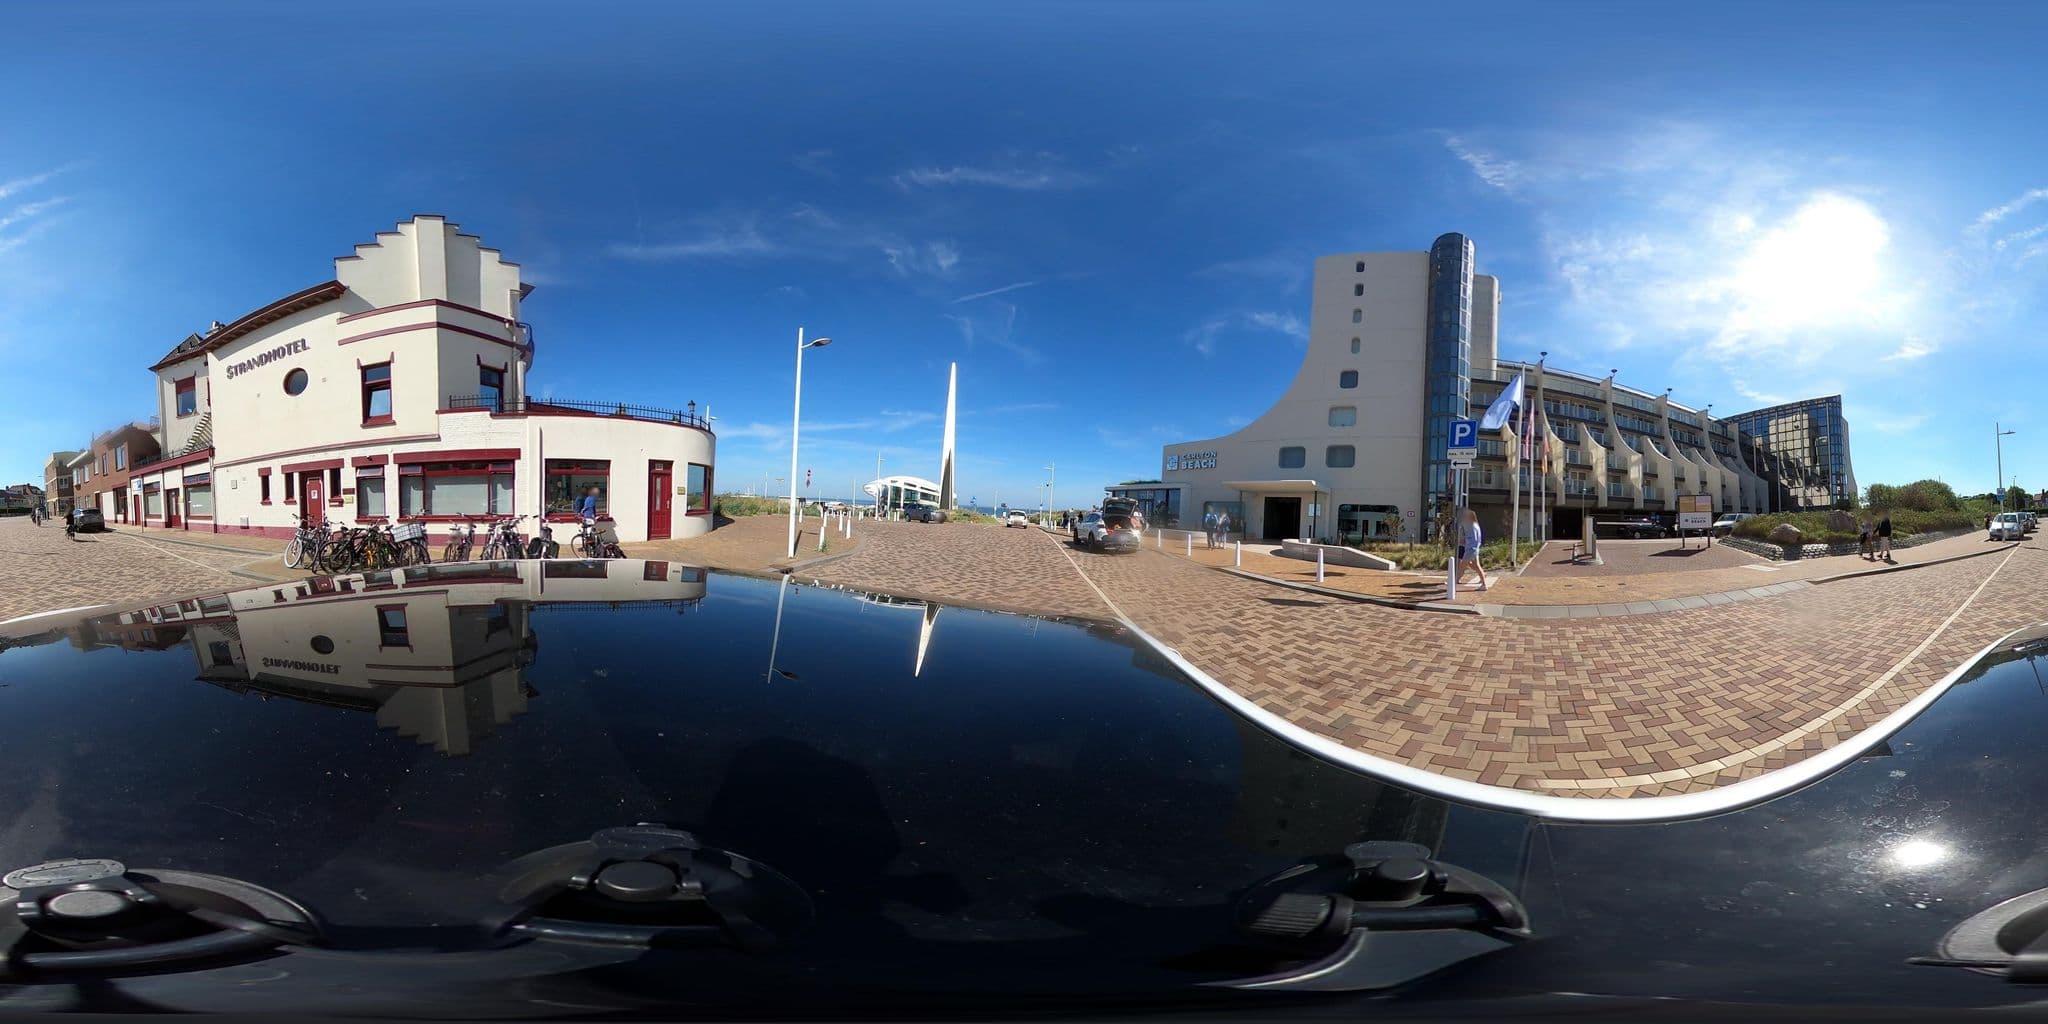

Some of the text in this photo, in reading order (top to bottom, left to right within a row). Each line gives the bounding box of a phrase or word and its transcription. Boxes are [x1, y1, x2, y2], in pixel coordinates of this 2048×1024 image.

[226, 338, 310, 379] STRANDHOTEL
[1455, 424, 1471, 445] P
[1181, 459, 1217, 470] BEACH
